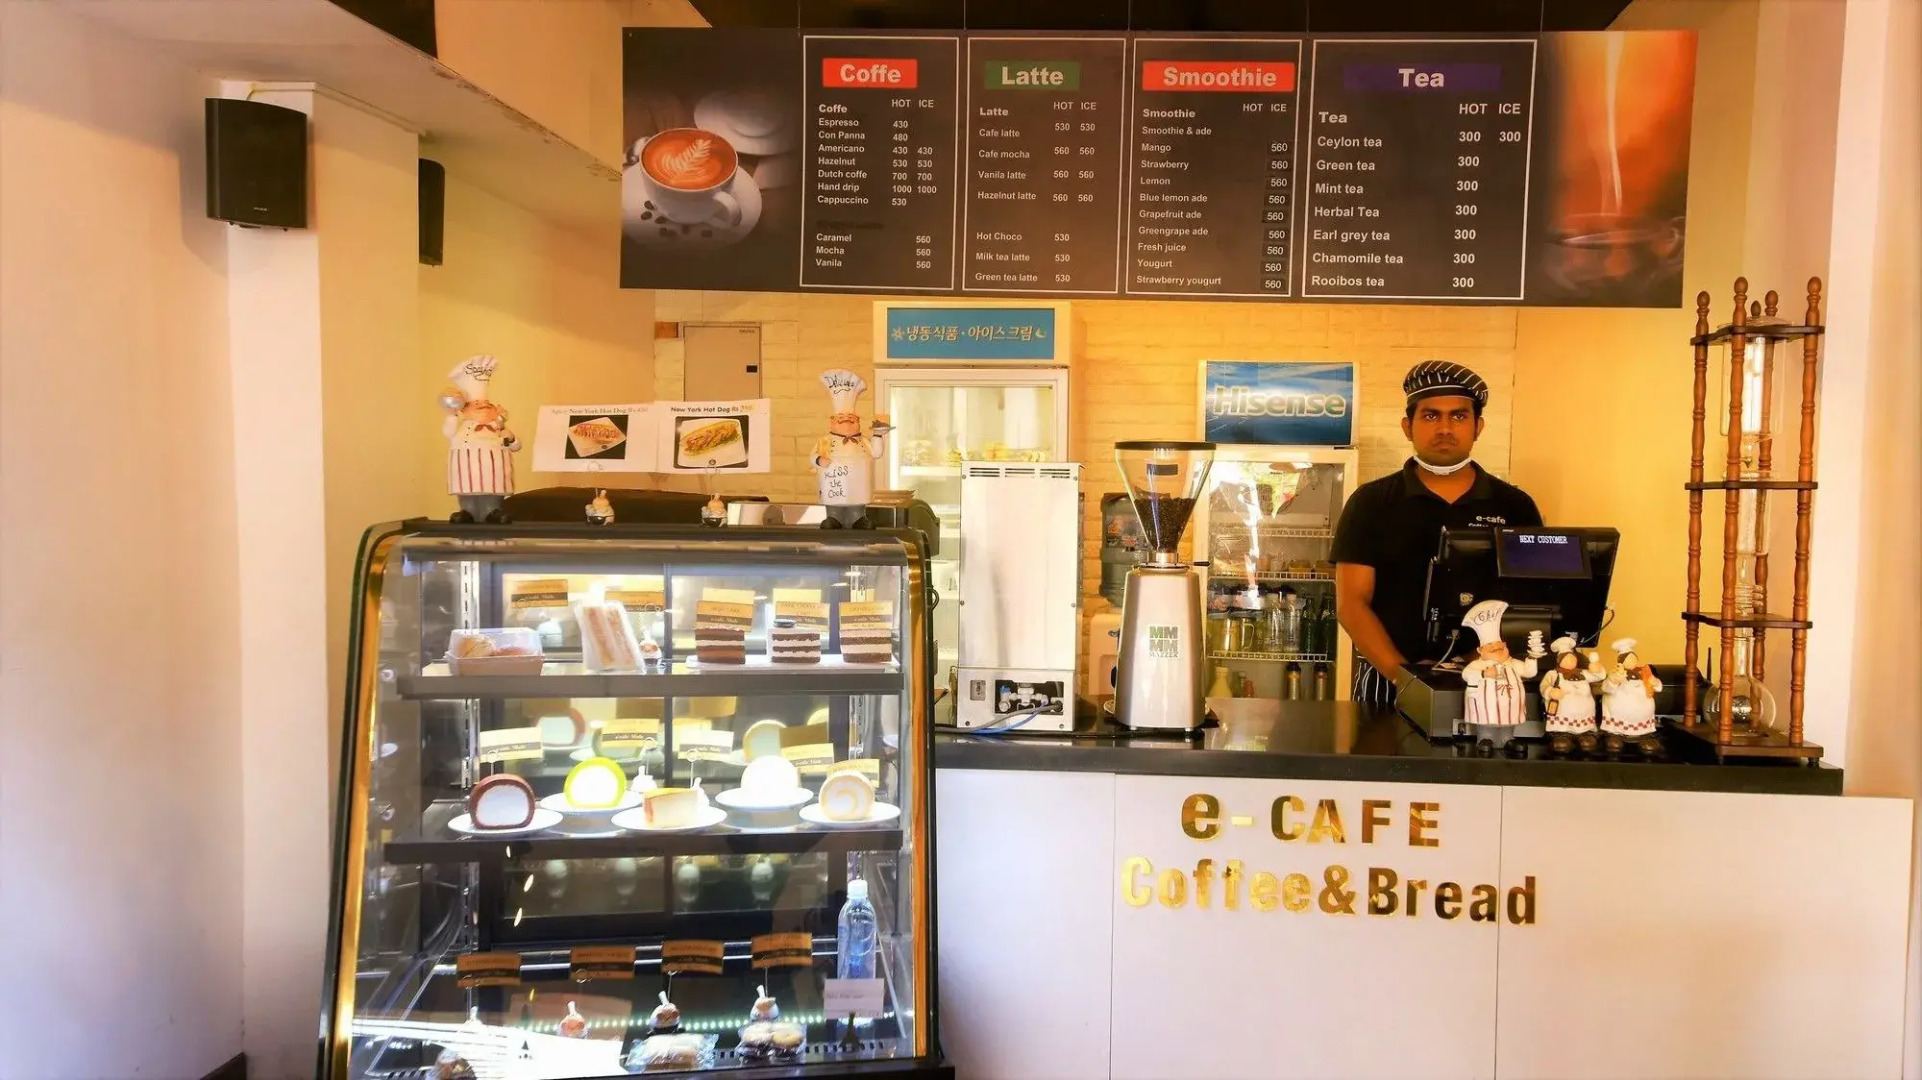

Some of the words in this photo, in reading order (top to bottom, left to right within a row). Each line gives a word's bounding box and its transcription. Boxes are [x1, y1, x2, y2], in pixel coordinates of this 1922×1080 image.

[839, 63, 902, 83] Coffe
[1001, 65, 1064, 86] Latte
[1163, 66, 1277, 88] Smoothie
[1398, 68, 1445, 88] Tea
[892, 99, 911, 107] HOT
[919, 100, 933, 108] ICE
[1054, 102, 1073, 110] HOT
[1081, 102, 1096, 110] ICE
[819, 104, 847, 113] Coffe
[980, 107, 1008, 115] Latte
[1143, 109, 1195, 117] Smoothie
[1459, 104, 1487, 114] HOT
[1499, 104, 1520, 114] ICE
[1319, 112, 1347, 123] Tea
[819, 118, 858, 127] Espresso
[1055, 123, 1070, 131] 530
[1081, 123, 1095, 131] 530
[979, 129, 998, 137] Cafe
[1001, 129, 1019, 137] latte
[1142, 126, 1184, 134] Smoothie
[1187, 127, 1192, 135] &
[1196, 127, 1211, 135] ade
[818, 131, 836, 140] Con
[838, 131, 866, 141] Panna
[893, 133, 908, 141] 480
[1459, 132, 1480, 141] 300
[1500, 132, 1520, 141] 300
[1271, 143, 1287, 151] 560
[1318, 136, 1359, 149] Ceylon
[1364, 137, 1381, 147] tea
[818, 144, 864, 152] Americano
[1080, 147, 1094, 155] 560
[1142, 143, 1171, 153] Mango
[979, 150, 998, 158] Cafe
[819, 157, 855, 165] Hazelnut
[1141, 160, 1189, 170] Strawberry
[1272, 161, 1288, 169] 560
[1317, 160, 1352, 170] Green
[1357, 161, 1375, 170] tea
[1458, 156, 1479, 166] 300
[817, 170, 843, 179] Dutch
[845, 170, 868, 180] coffe
[1007, 171, 1026, 179] latte
[817, 183, 840, 192] Hand
[842, 183, 860, 193] drip
[893, 185, 912, 193] 1000
[1316, 183, 1341, 193] Mint
[1345, 184, 1363, 193] tea
[1457, 181, 1478, 191] 300
[978, 191, 1015, 199] Hazelnut
[1078, 194, 1093, 202] 560
[1140, 193, 1159, 201] Blue
[1162, 194, 1189, 202] lemon
[1192, 194, 1207, 202] ade
[818, 195, 868, 205] Cappuccino
[892, 198, 906, 206] 530
[1269, 196, 1285, 204] 560
[1139, 210, 1183, 219] Grapefruit
[1315, 207, 1353, 216] Herbal
[1358, 207, 1379, 217] Tea
[1456, 205, 1477, 215] 300
[1267, 212, 1283, 220] 560
[1139, 227, 1190, 236] Greengrape
[1314, 230, 1337, 239] Earl
[1341, 232, 1368, 242] grey
[1372, 231, 1390, 240] tea
[1455, 230, 1476, 239] 300
[817, 233, 851, 241] Caramel
[816, 246, 844, 254] Mocha
[1138, 243, 1162, 251] Fresh
[1165, 243, 1186, 252] juice
[1267, 247, 1283, 255] 560
[1055, 254, 1070, 262] 530
[1313, 253, 1381, 263] Chamomile
[1385, 254, 1403, 263] tea
[1454, 254, 1475, 263] 300
[1138, 259, 1172, 269] Yougurt
[1265, 263, 1281, 271] 560
[974, 273, 1001, 283] Green
[1003, 273, 1017, 282] tea
[1018, 273, 1038, 283] latte
[1055, 274, 1070, 282] 530
[1137, 276, 1184, 285] Strawberry
[1187, 278, 1221, 286] yougurt
[1312, 276, 1362, 286] Rooibos
[1366, 277, 1384, 286] tea
[1453, 277, 1474, 287] 300
[1265, 280, 1281, 288] 560
[1212, 385, 1347, 418] Hisense
[830, 479, 842, 488] the
[1476, 515, 1506, 525] e-cafe
[1519, 535, 1535, 544] NEXT
[1537, 535, 1568, 544] CUSTOMER
[1120, 855, 1537, 926] Coffee&Bread
